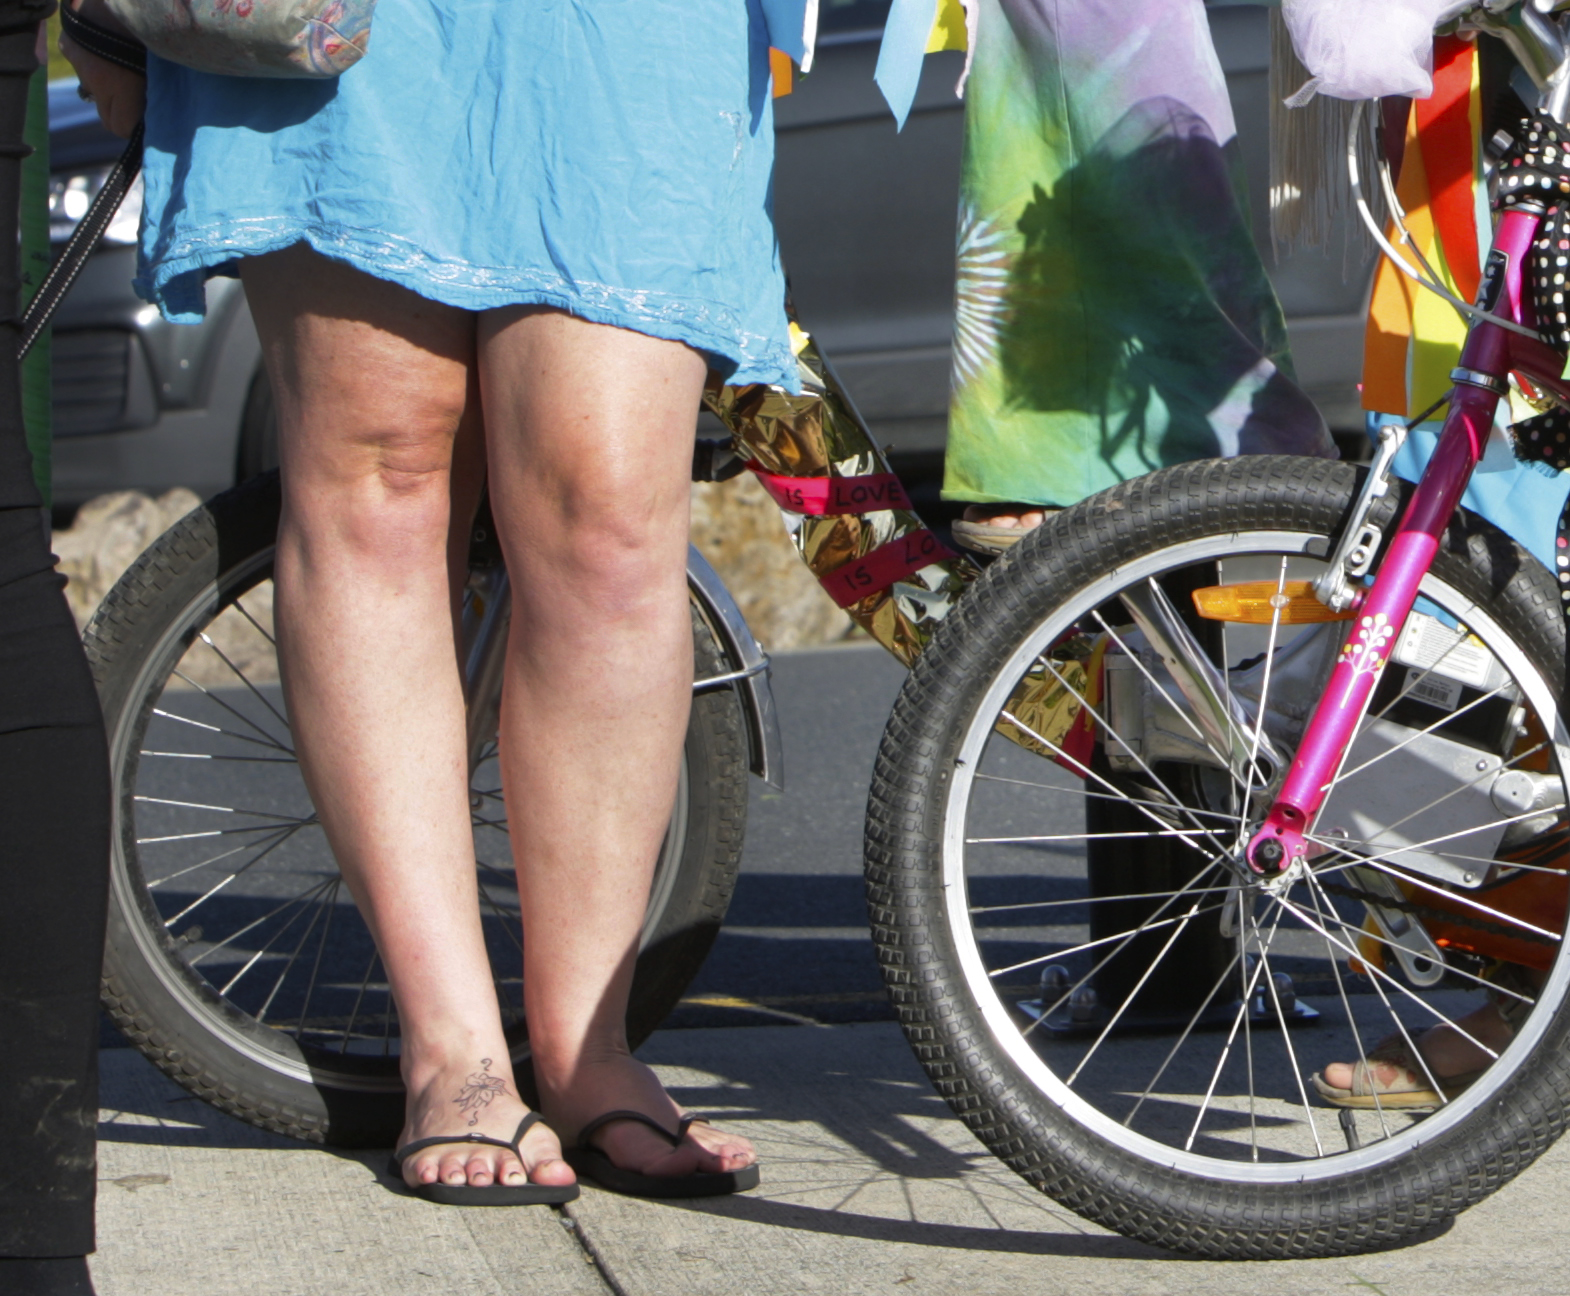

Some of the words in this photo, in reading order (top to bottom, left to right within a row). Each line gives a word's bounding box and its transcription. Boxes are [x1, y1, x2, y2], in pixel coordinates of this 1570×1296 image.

[785, 488, 804, 506] IS
[835, 481, 902, 507] LOVE
[843, 566, 873, 590] IS
[904, 535, 941, 564] LO
